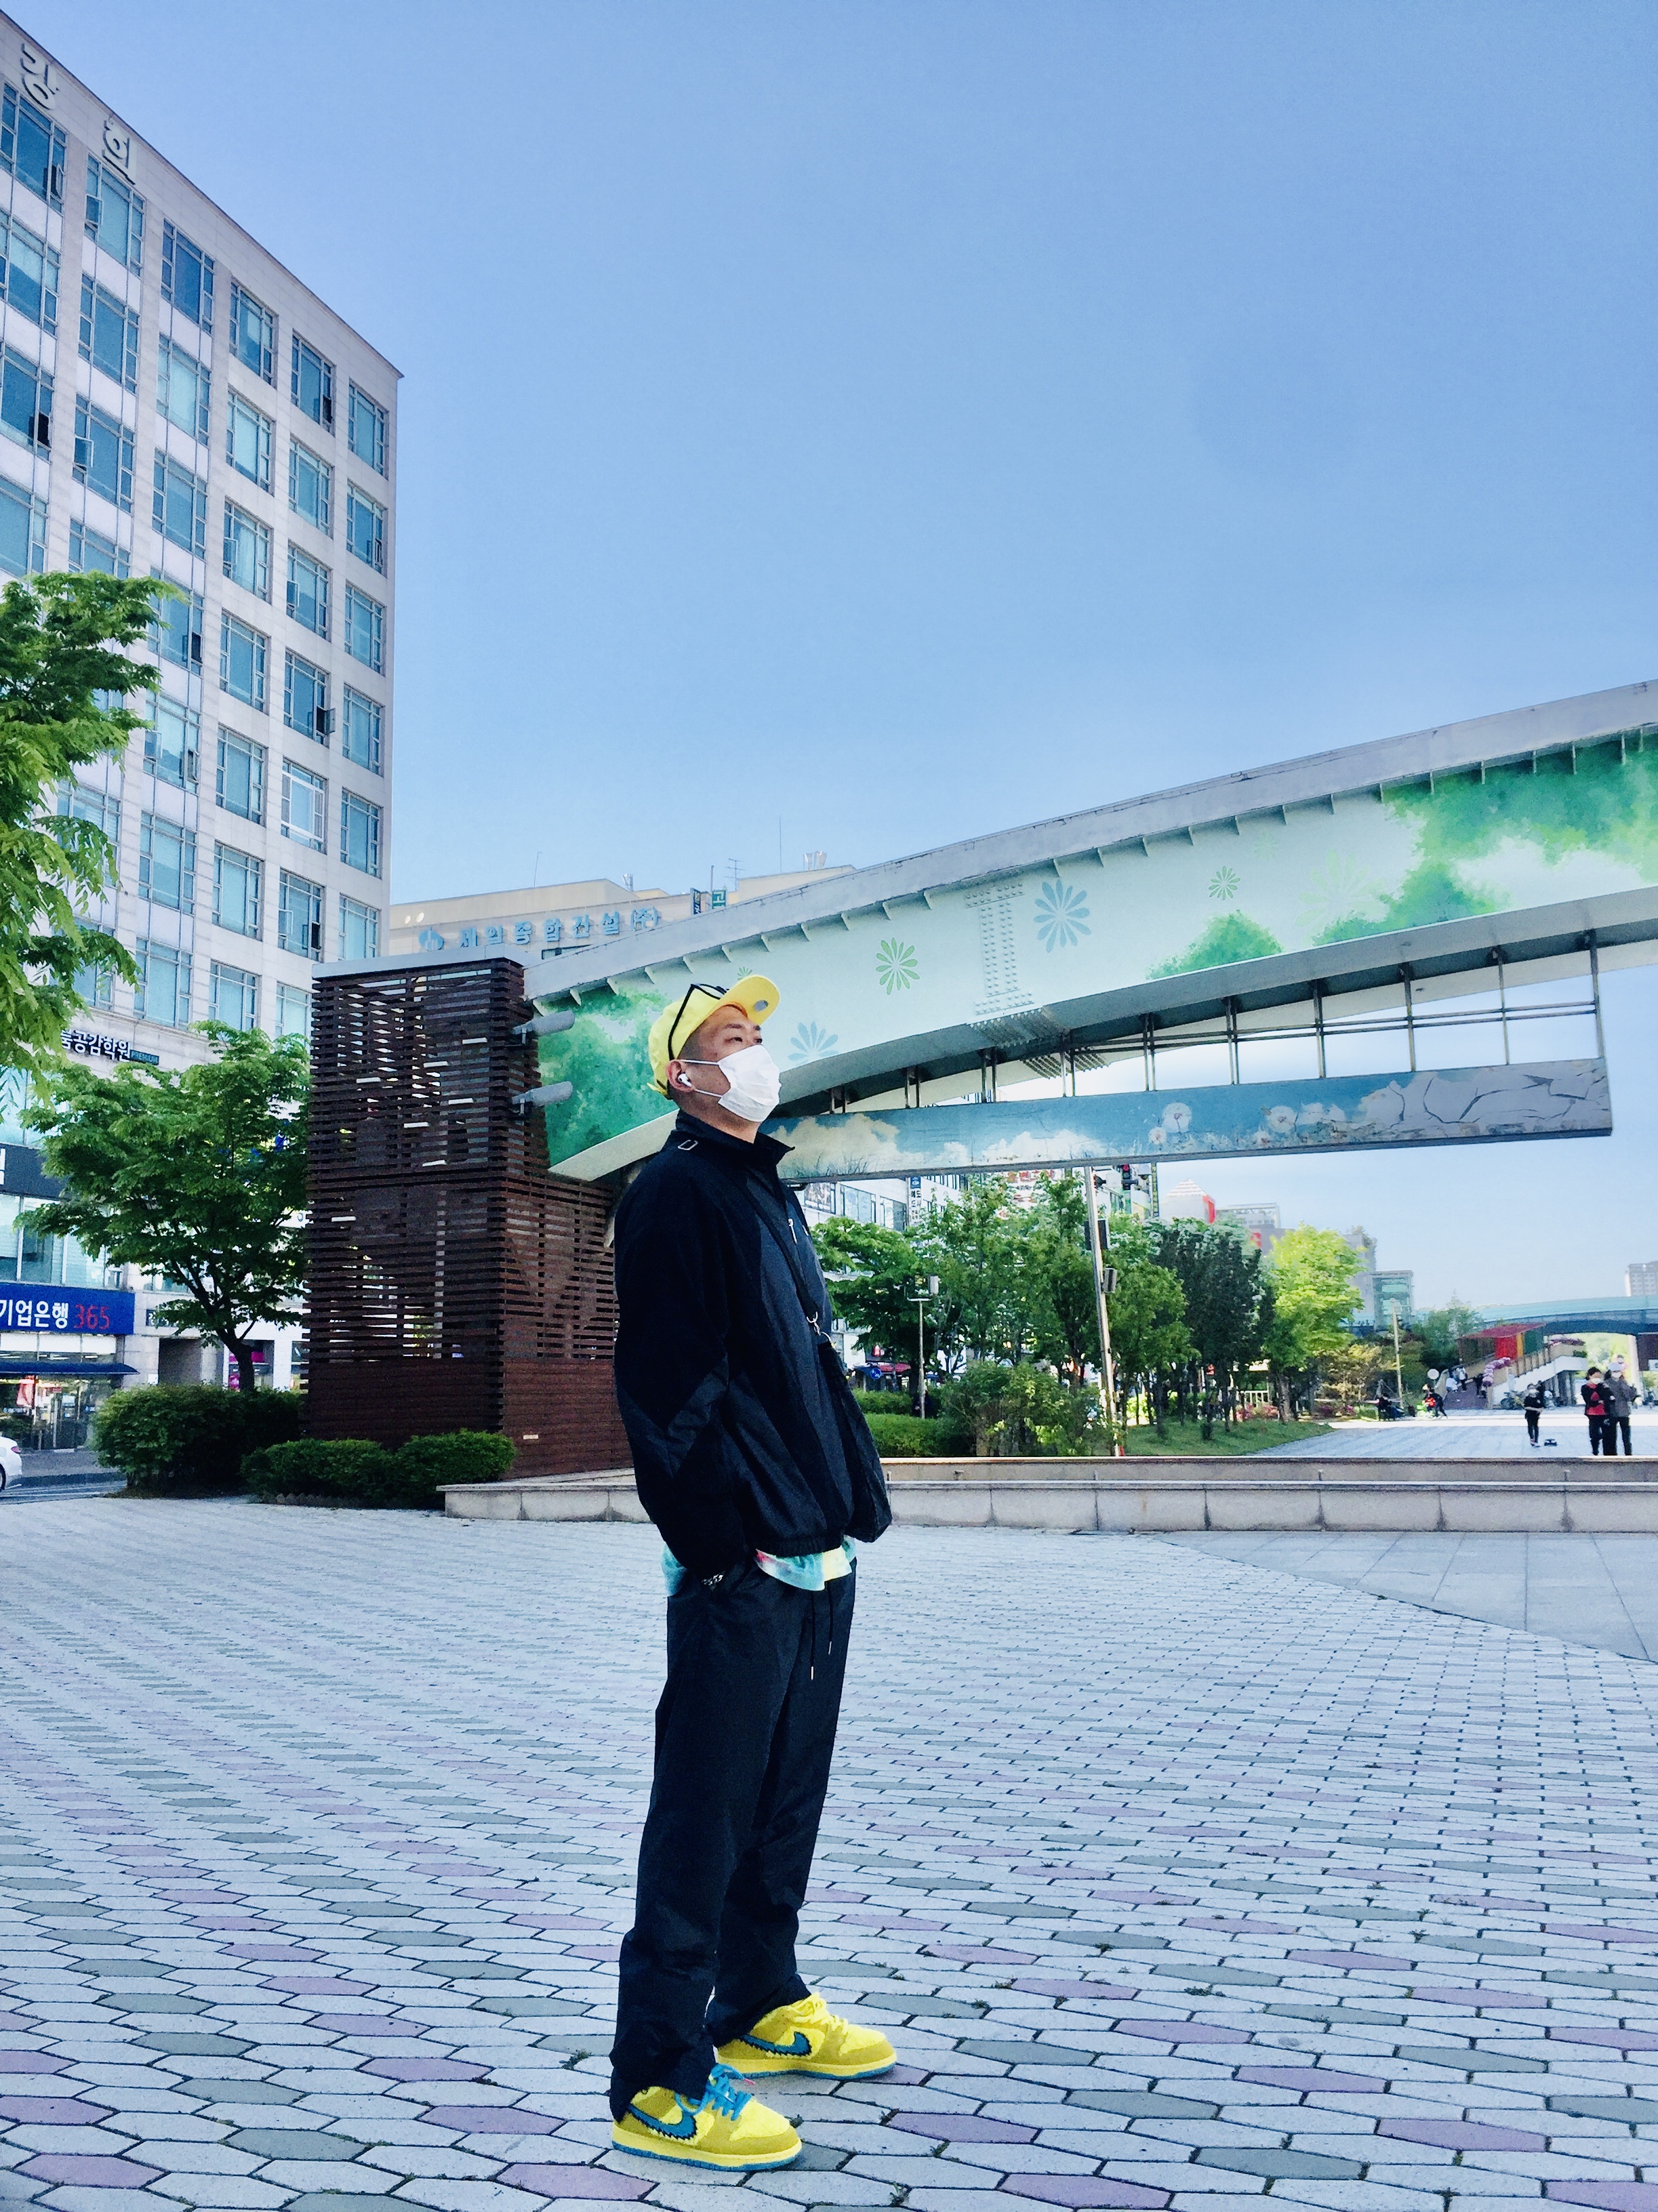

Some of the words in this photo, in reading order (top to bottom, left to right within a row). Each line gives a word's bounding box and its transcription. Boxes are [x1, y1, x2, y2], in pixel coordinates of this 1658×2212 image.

[131, 1050, 159, 1064] PREMIUM
[0, 1299, 68, 1329] 기업은행
[74, 1304, 110, 1330] 365
